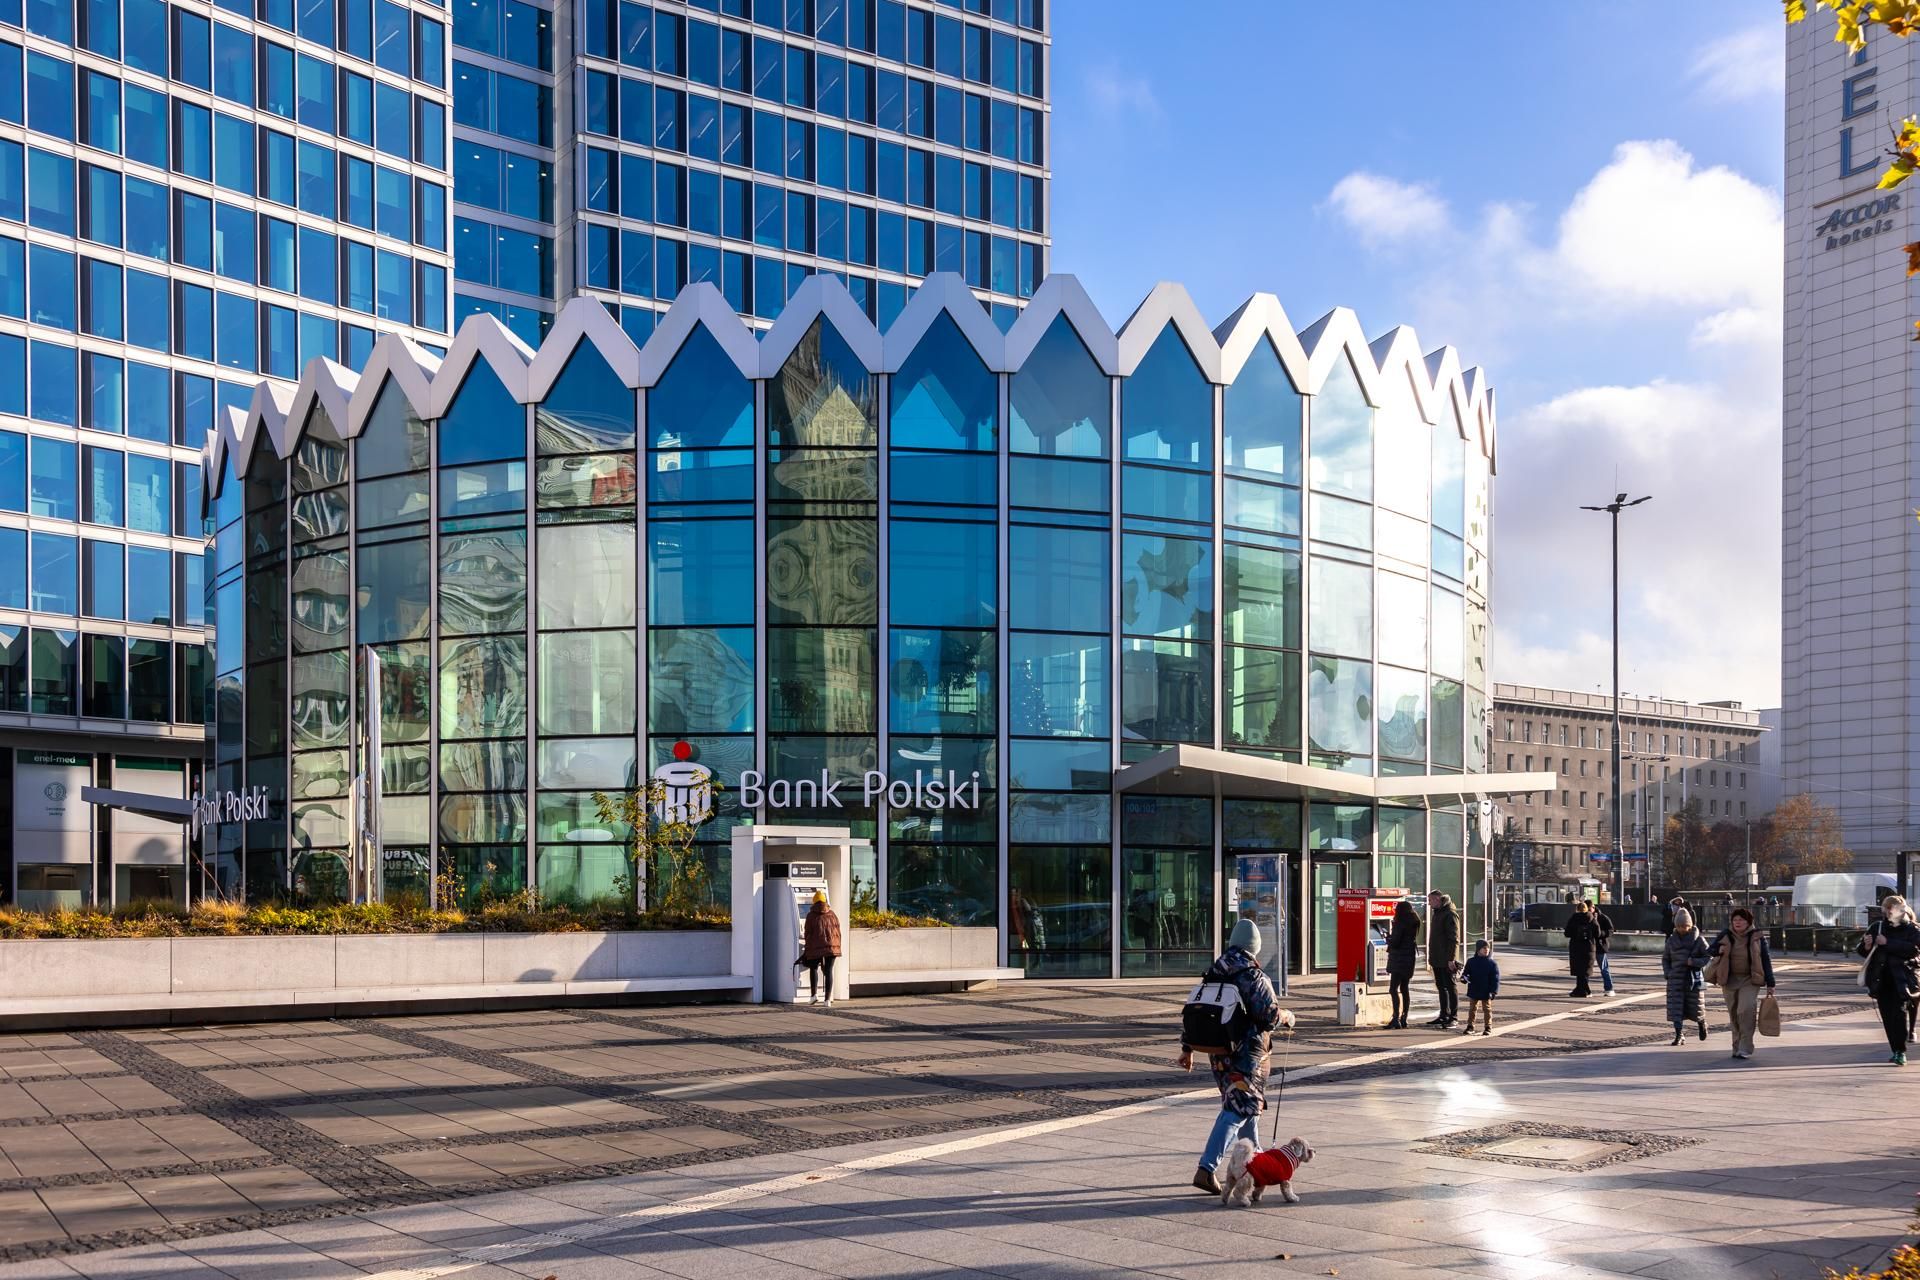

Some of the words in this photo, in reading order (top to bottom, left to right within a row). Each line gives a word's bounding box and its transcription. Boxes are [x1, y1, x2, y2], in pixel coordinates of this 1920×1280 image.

[1825, 217, 1894, 251] hotels
[33, 754, 76, 764] enel-med
[200, 790, 222, 826] Bank
[226, 785, 268, 822] Polski
[739, 768, 844, 809] Bank
[863, 768, 980, 810] Polski
[1371, 903, 1387, 913] Bilety
